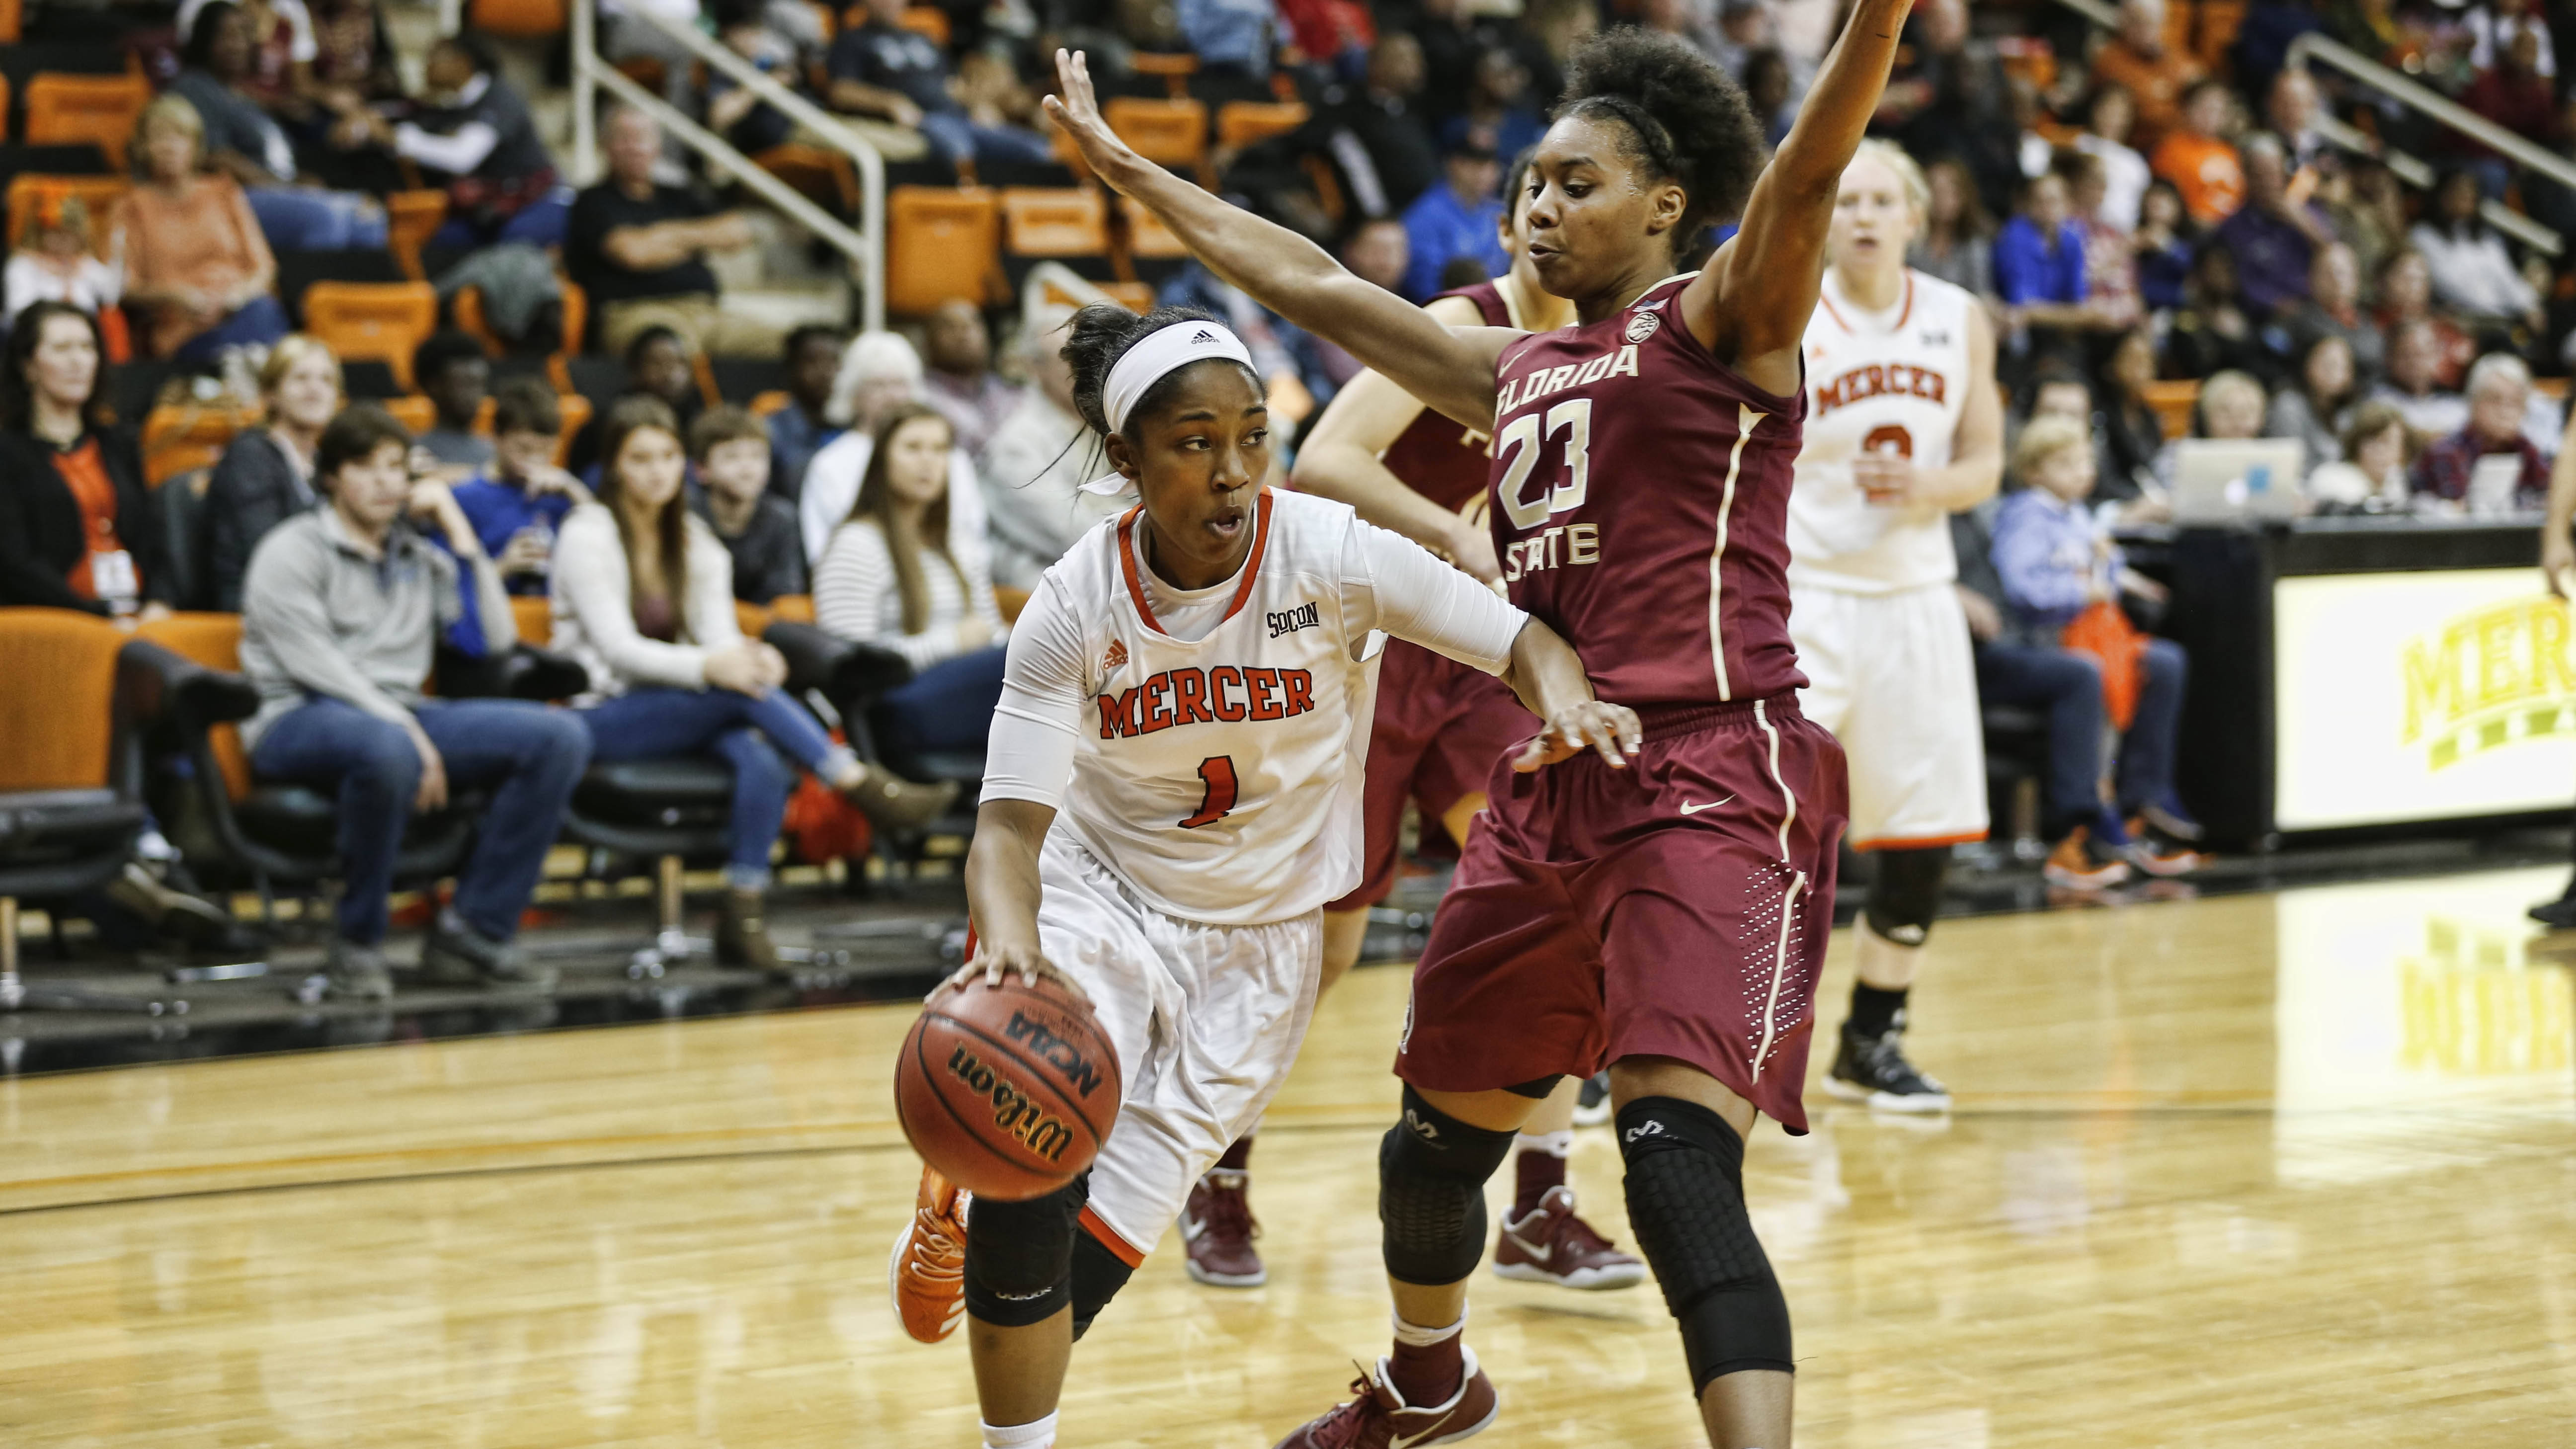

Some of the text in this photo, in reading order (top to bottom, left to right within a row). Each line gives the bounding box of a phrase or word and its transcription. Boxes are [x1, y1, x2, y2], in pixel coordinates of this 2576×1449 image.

[1492, 344, 1639, 431] FLORIDA
[1817, 364, 1945, 416] MERCER
[1497, 399, 1592, 530] 23
[1505, 523, 1601, 582] STATE
[1097, 666, 1315, 739] MERCER
[1177, 755, 1239, 829] 1
[1006, 1010, 1103, 1099] NCAA
[947, 1041, 1074, 1162] Wilson
